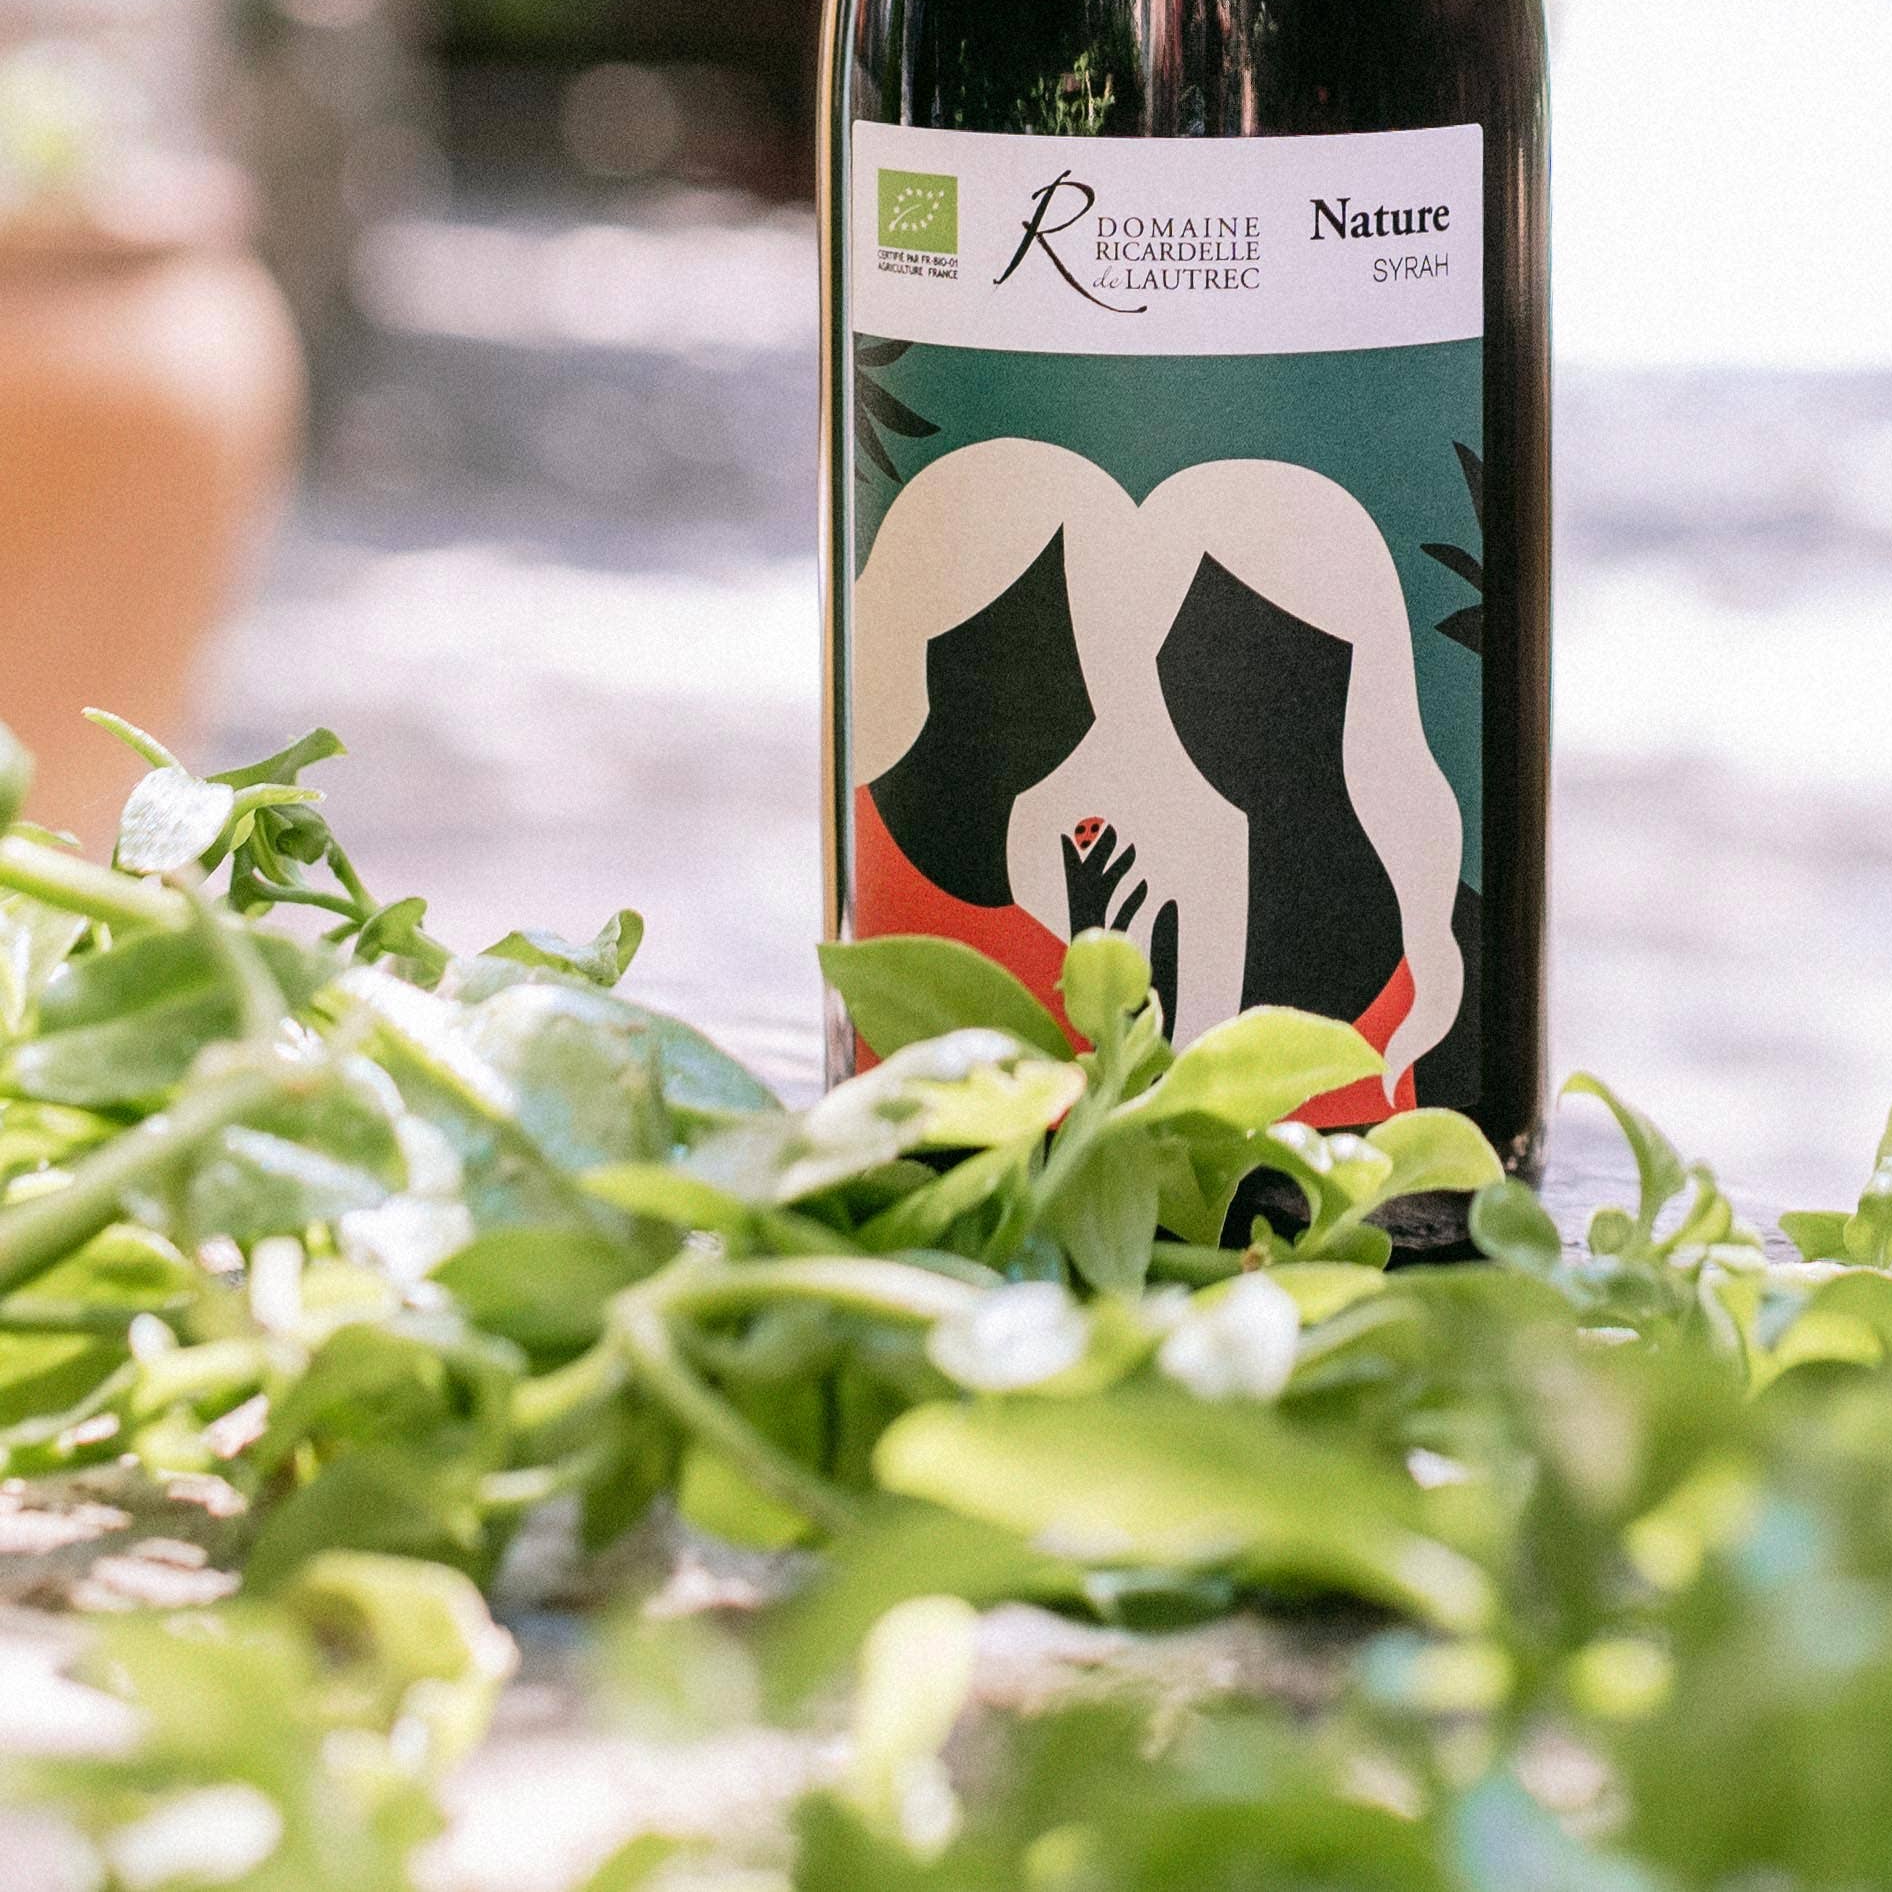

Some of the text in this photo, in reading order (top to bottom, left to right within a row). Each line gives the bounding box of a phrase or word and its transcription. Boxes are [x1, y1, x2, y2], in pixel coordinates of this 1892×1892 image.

[1096, 216, 1261, 239] DOMAINE
[1309, 196, 1451, 241] Nature
[1095, 241, 1262, 262] RICARDELLE
[927, 267, 958, 280] FRANCE
[1092, 265, 1261, 290] de LAUTREC
[1372, 252, 1449, 283] SYRAH
